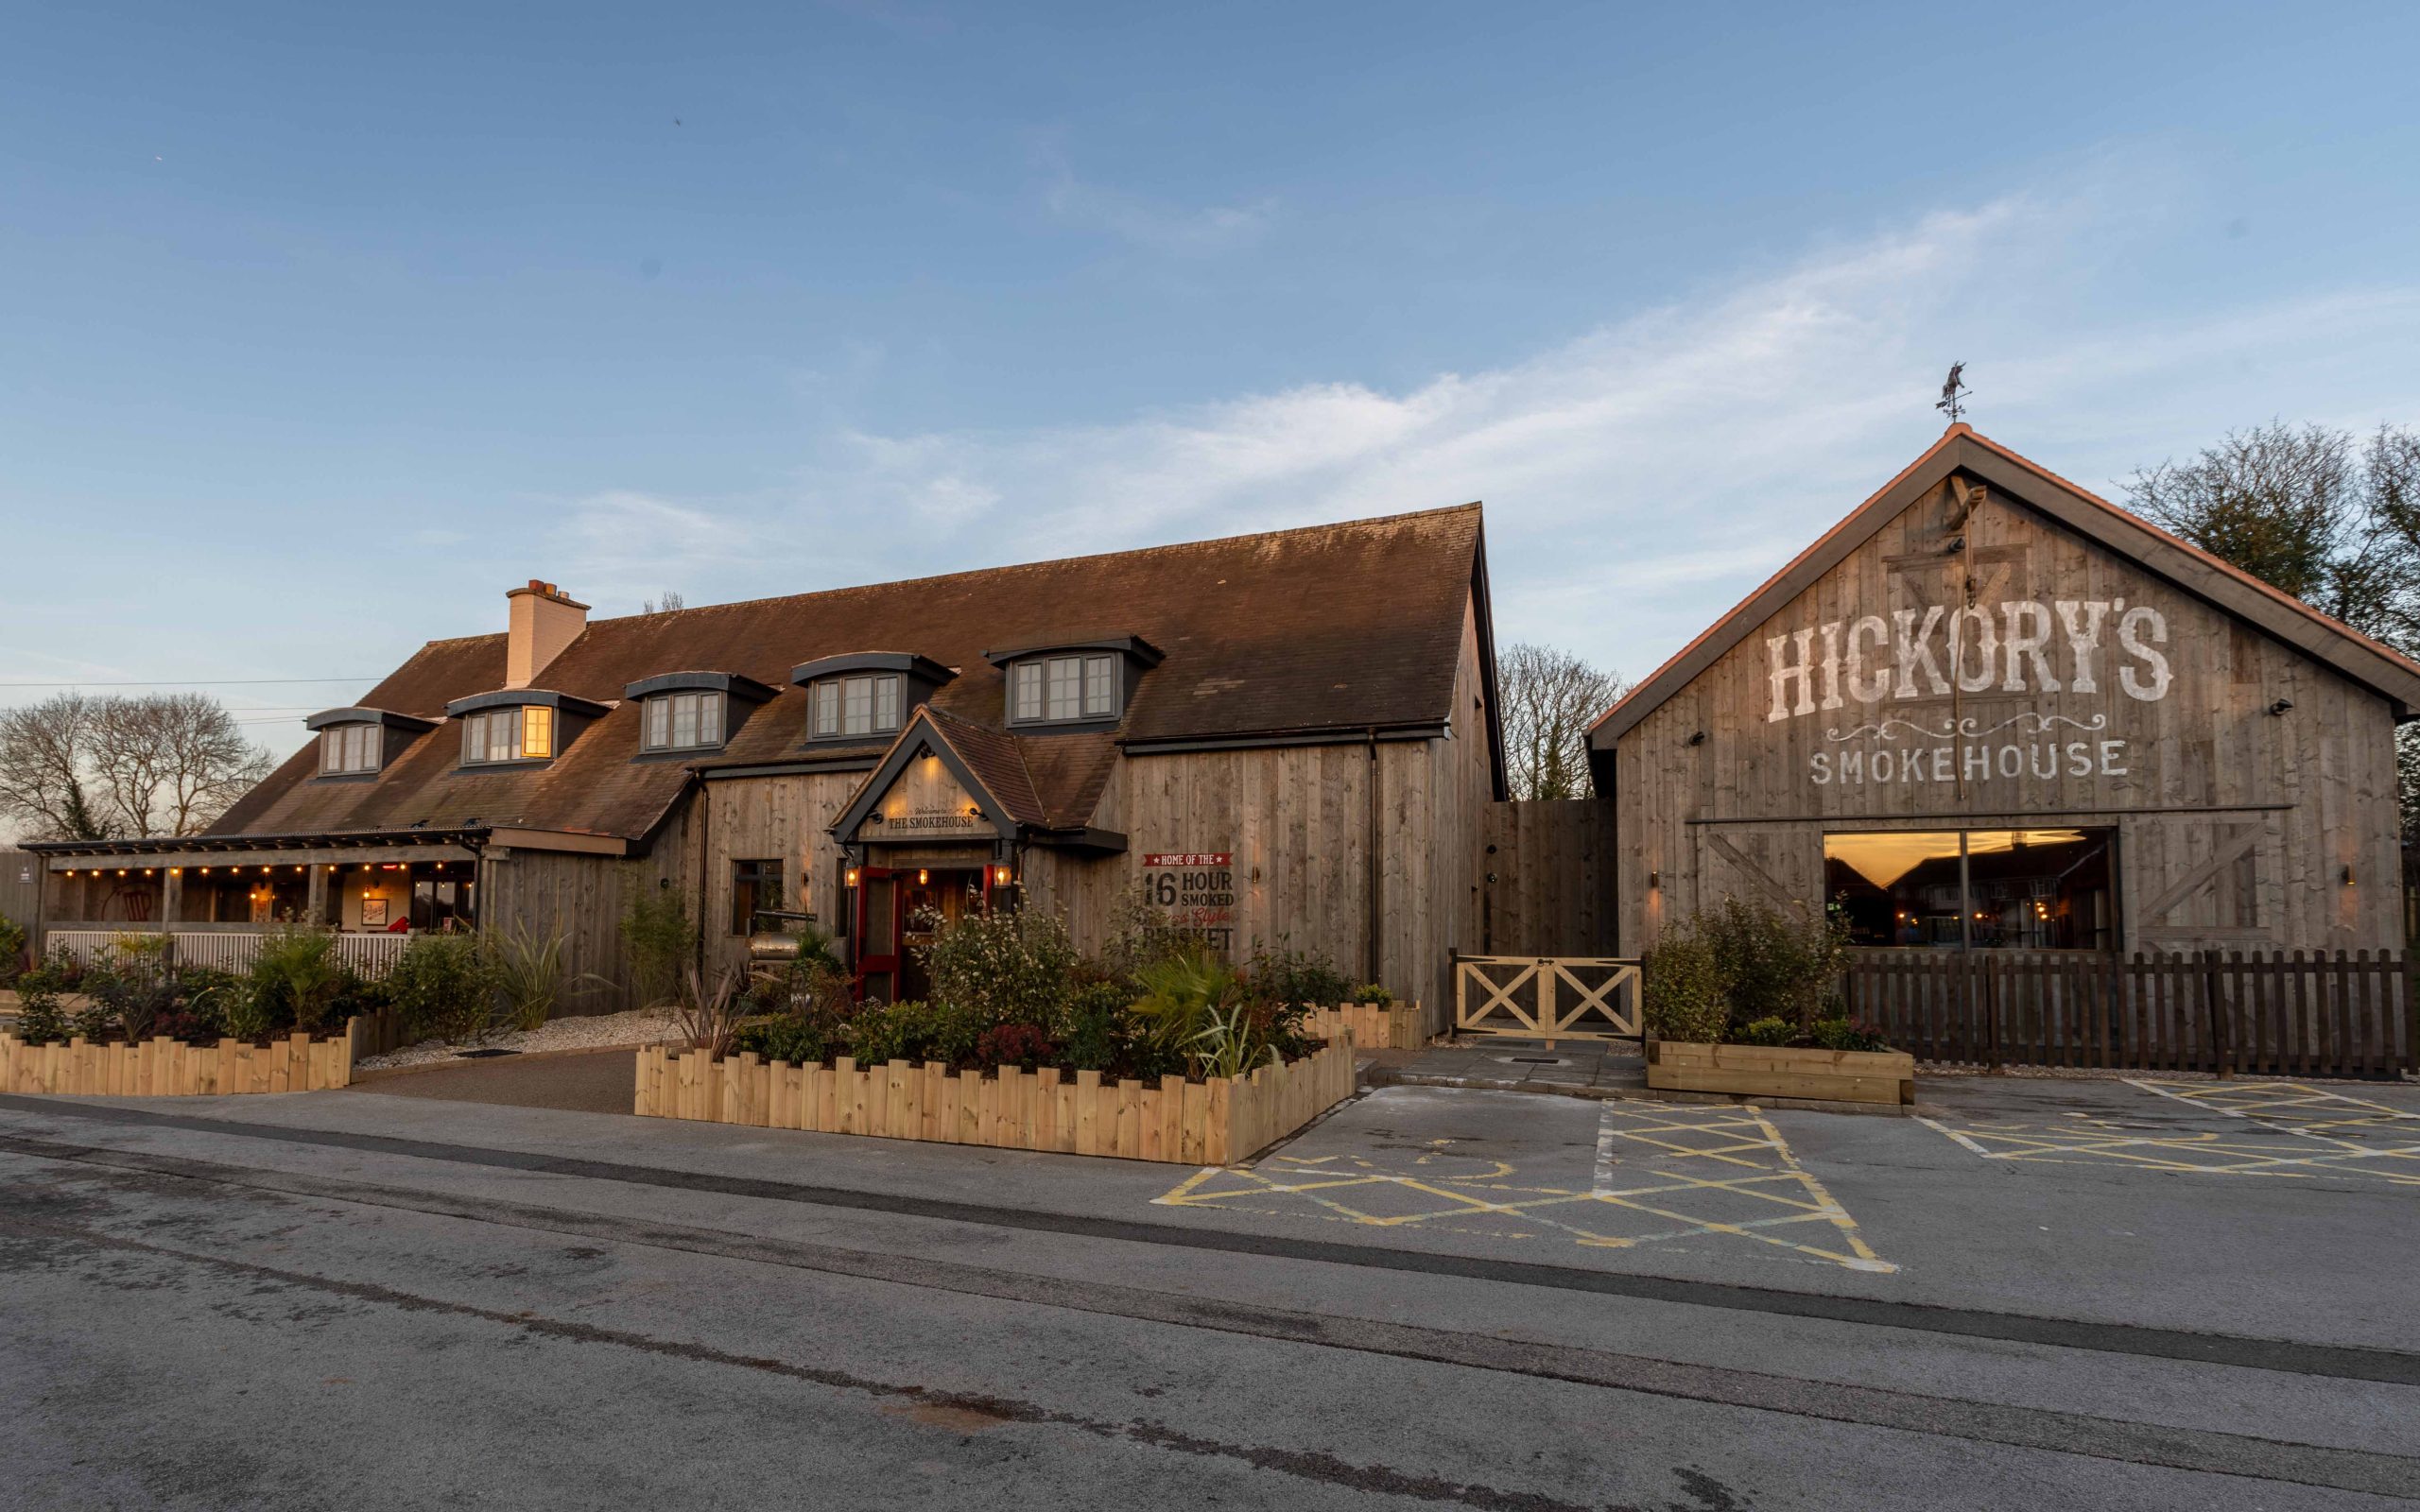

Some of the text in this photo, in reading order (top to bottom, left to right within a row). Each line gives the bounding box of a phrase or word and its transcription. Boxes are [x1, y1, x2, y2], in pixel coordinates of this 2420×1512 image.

[1766, 597, 2173, 723] HICKORY'S
[1809, 739, 2129, 784] SMOKEHOUSE
[889, 816, 974, 829] THE SMOKEHOUSE
[1161, 853, 1215, 866] HOME OF THE
[1145, 871, 1233, 906] 16 HOUR
[1181, 893, 1235, 906] SMOKED
[1191, 907, 1230, 927] Style
